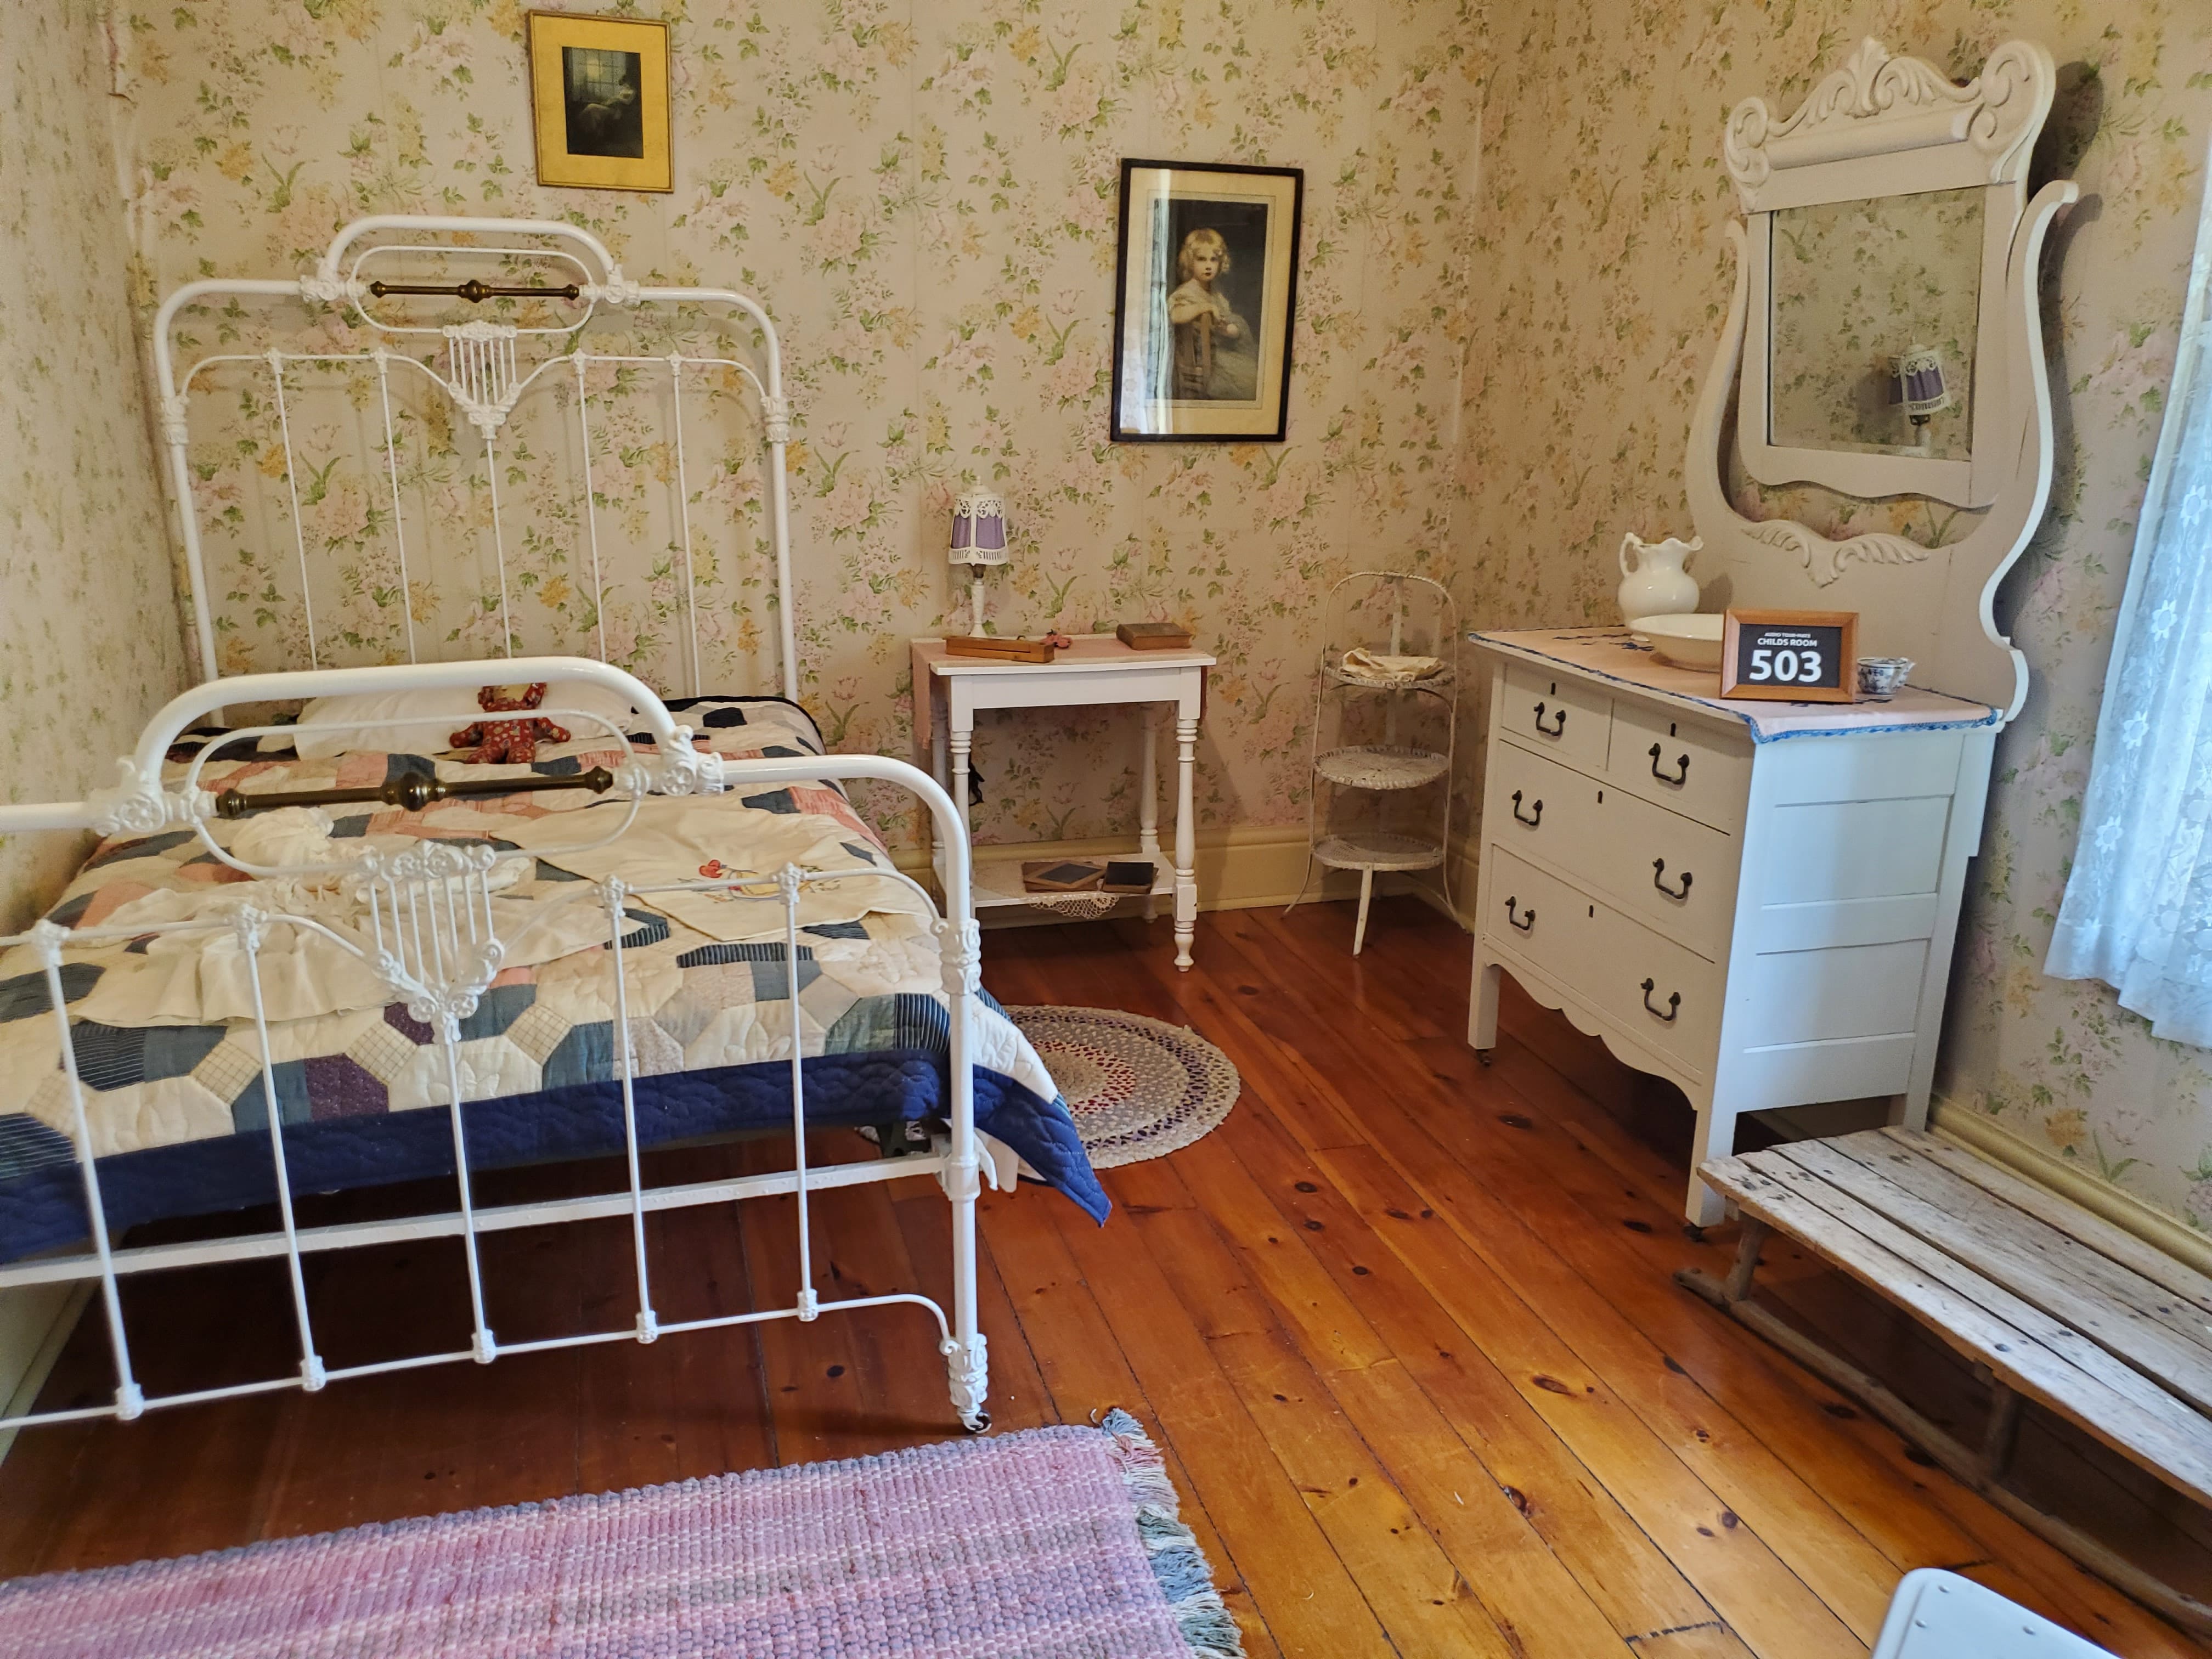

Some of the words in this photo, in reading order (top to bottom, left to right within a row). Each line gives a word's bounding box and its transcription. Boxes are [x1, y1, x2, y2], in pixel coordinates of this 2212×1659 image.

[1757, 637, 1788, 646] CHILDS
[1790, 639, 1817, 647] ROOM
[1749, 650, 1821, 682] 503
